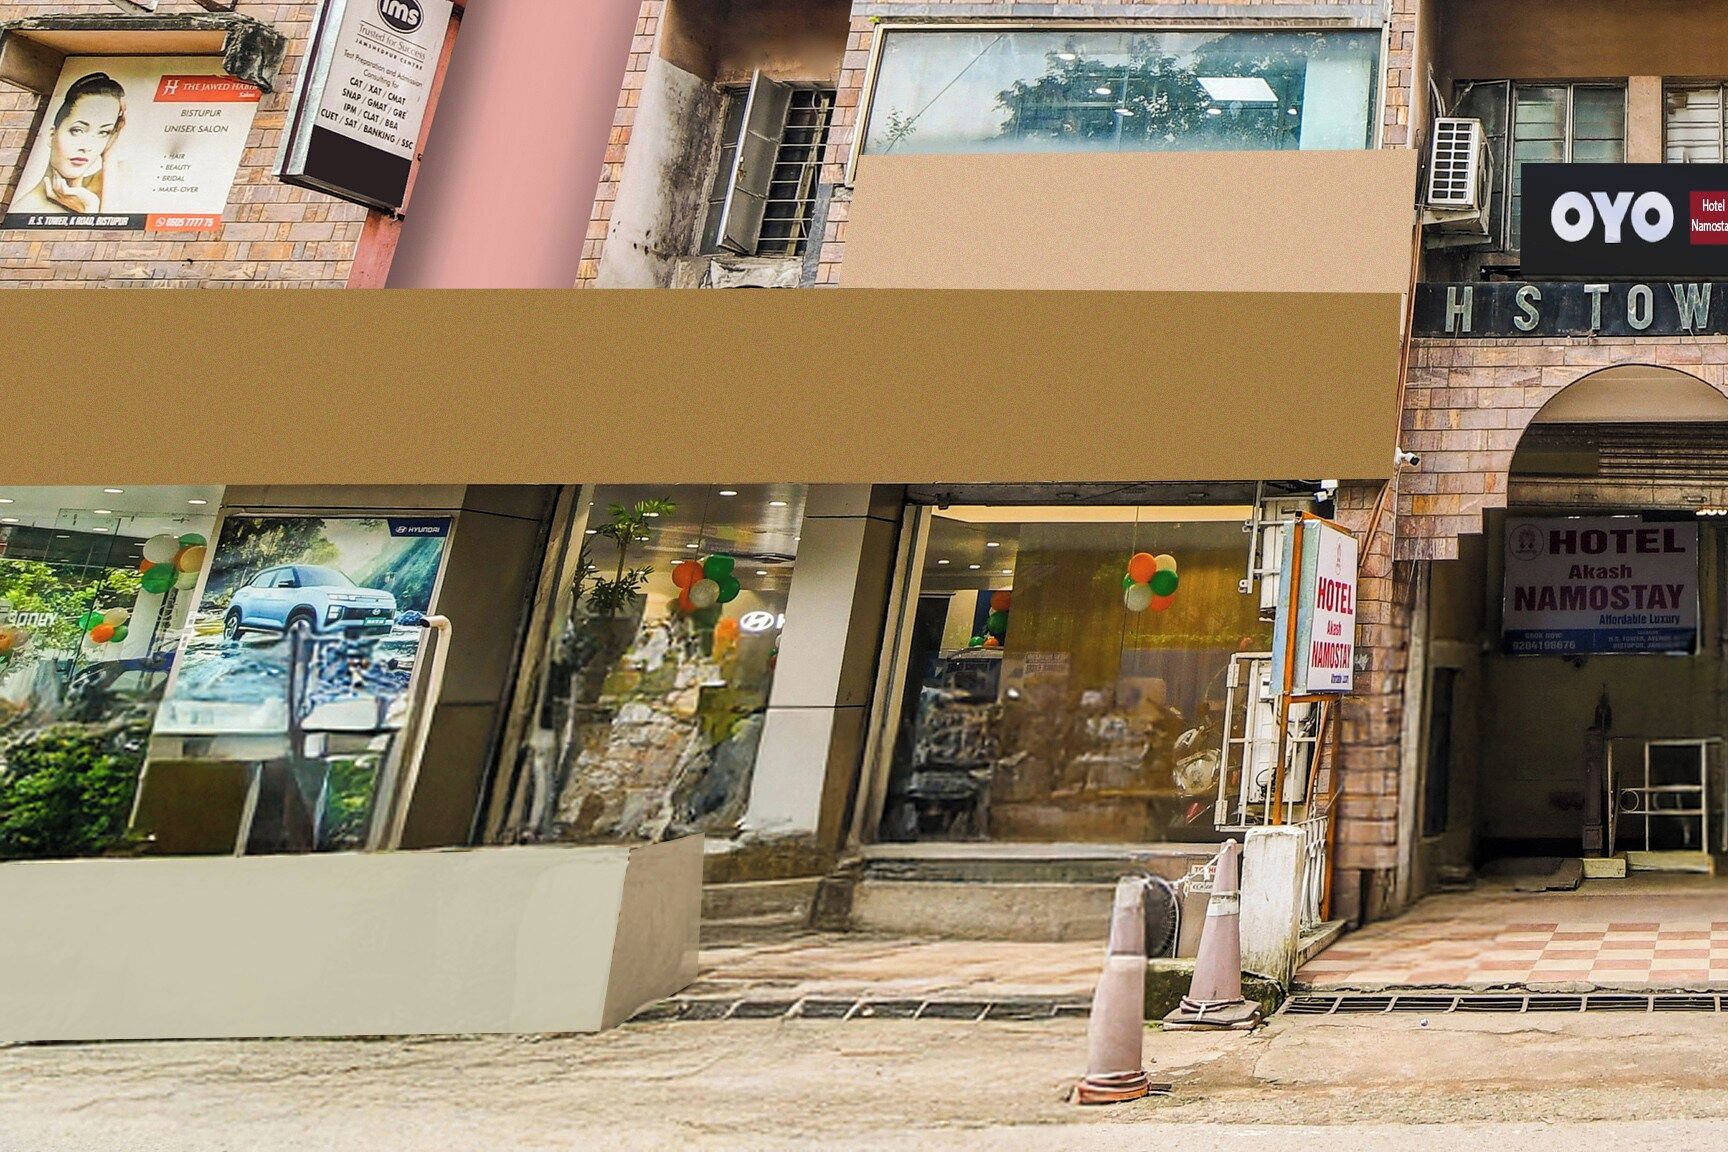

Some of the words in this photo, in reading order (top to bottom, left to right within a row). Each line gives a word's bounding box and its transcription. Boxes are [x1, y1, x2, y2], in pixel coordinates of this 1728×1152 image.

[355, 38, 398, 60] JAMSHEDPUR
[359, 23, 386, 43] Trusted
[386, 36, 397, 47] for
[398, 41, 426, 61] Success
[343, 49, 355, 59] Test
[354, 54, 386, 73] Preparation
[386, 68, 397, 77] and
[397, 73, 423, 88] Admission
[363, 69, 391, 88] Consulting
[183, 83, 200, 91] THE
[201, 83, 230, 91] JAWED
[349, 77, 363, 88] CAT
[368, 84, 383, 96] XAT
[387, 92, 406, 105] CMAT
[180, 109, 222, 117] BISTUPUR
[342, 88, 362, 101] SNAP
[367, 98, 388, 112] GMAT
[392, 108, 407, 120] GRE
[343, 103, 357, 114] IPM
[363, 110, 379, 123] CLAT
[384, 118, 398, 130] BBA
[164, 125, 197, 133] UNISEX
[197, 125, 229, 133] SALON
[320, 108, 339, 122] CUET
[344, 117, 358, 128] SAT
[363, 124, 395, 143] BANKING
[400, 138, 414, 150] SSC
[1551, 191, 1674, 244] OYO
[1702, 199, 1726, 212] Hotel
[1550, 528, 1686, 555] HOTEL
[1568, 564, 1632, 579] Akash
[1317, 576, 1353, 615] HOTEL
[1514, 584, 1685, 612] NAMOSTAY
[1327, 620, 1342, 636] Akash
[1599, 613, 1647, 625] Affordable
[1650, 614, 1680, 627] Luxury
[1311, 641, 1352, 669] NAMOSTAY
